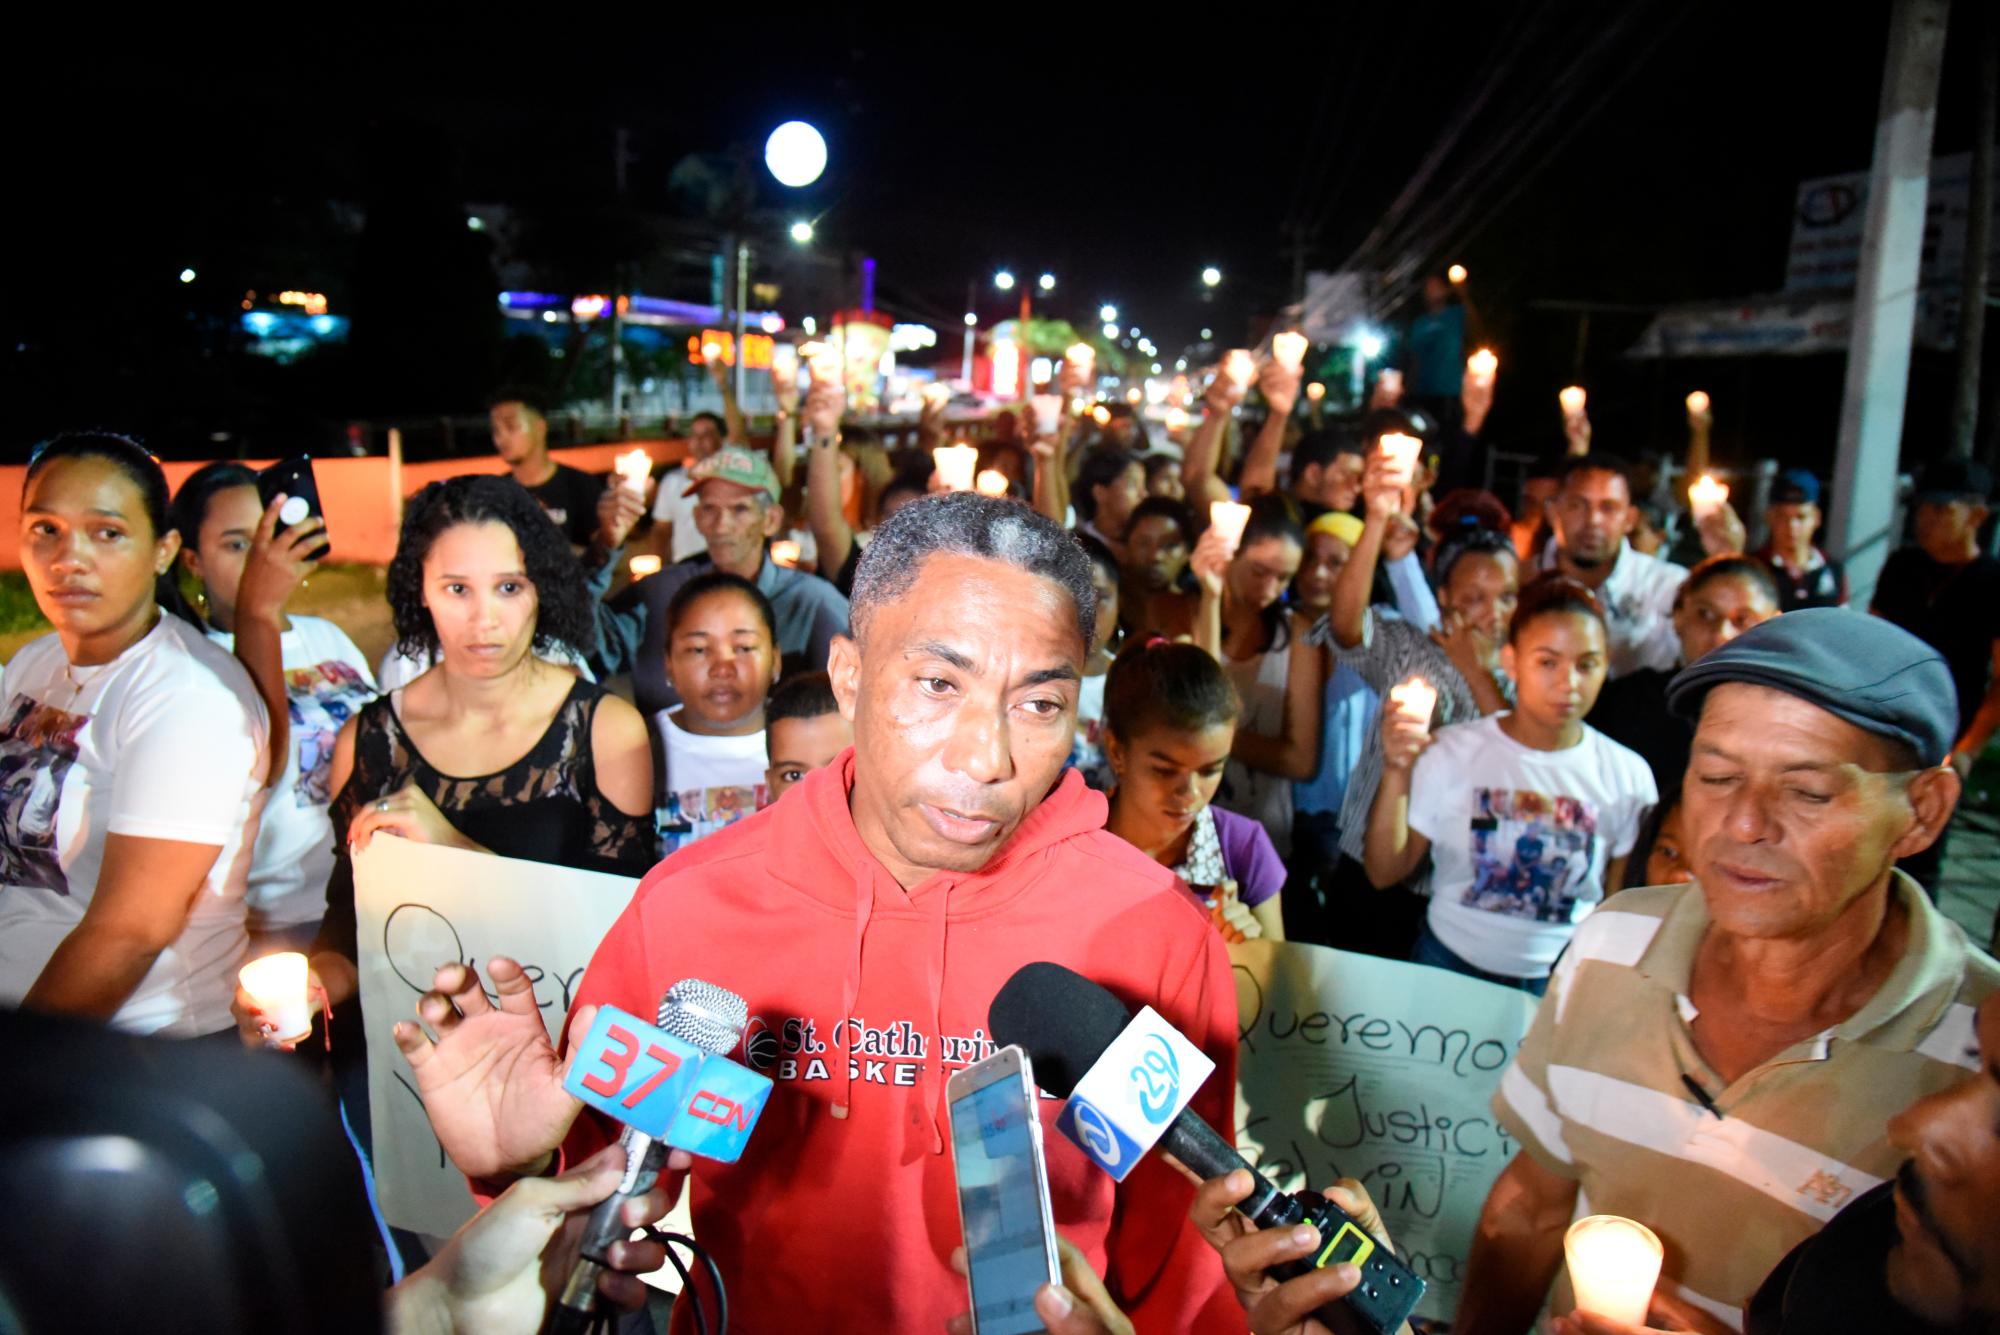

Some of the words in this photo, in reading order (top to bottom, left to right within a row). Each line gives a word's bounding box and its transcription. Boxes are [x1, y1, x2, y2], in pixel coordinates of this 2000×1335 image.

[782, 1017, 827, 1054] St.
[1231, 964, 1525, 1077] Queremo
[581, 1023, 682, 1110] 37
[1130, 1050, 1179, 1099] 29
[687, 1089, 755, 1132] CDN
